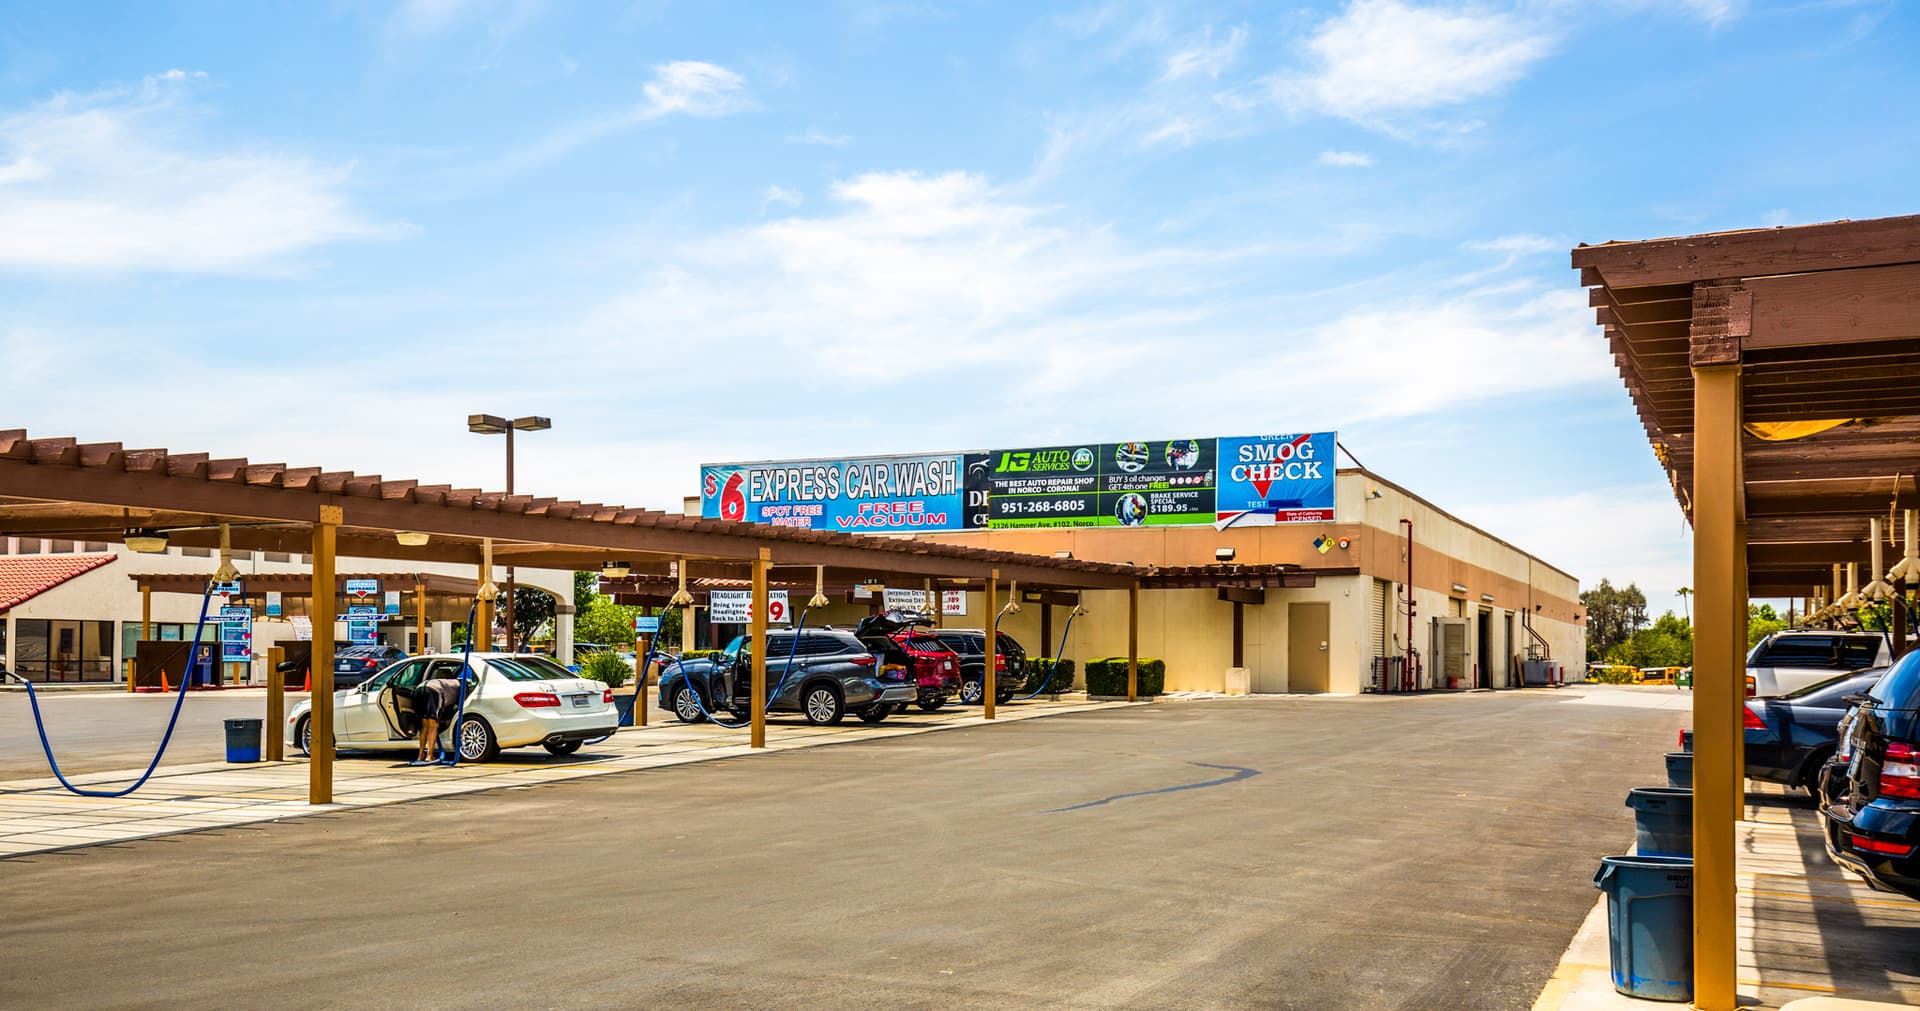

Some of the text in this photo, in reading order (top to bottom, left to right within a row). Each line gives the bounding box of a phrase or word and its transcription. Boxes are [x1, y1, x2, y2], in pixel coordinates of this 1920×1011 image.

[1032, 450, 1070, 463] AUTO
[1238, 441, 1315, 462] SMOG
[1032, 462, 1070, 472] SERVICES
[1230, 460, 1323, 483] CHECK
[750, 460, 957, 502] EXPRESS CAR WASH
[1028, 479, 1046, 487] AUTO
[1047, 478, 1073, 486] REPAIR
[1074, 477, 1094, 485] SHOP
[1138, 474, 1166, 483] changes
[762, 504, 823, 516] SPOT FREE
[858, 501, 924, 514] FREE
[1001, 500, 1085, 513] 951-268-6805
[1150, 504, 1188, 513] $189.95
[772, 517, 811, 527] WATER
[836, 513, 947, 527] VACUUM
